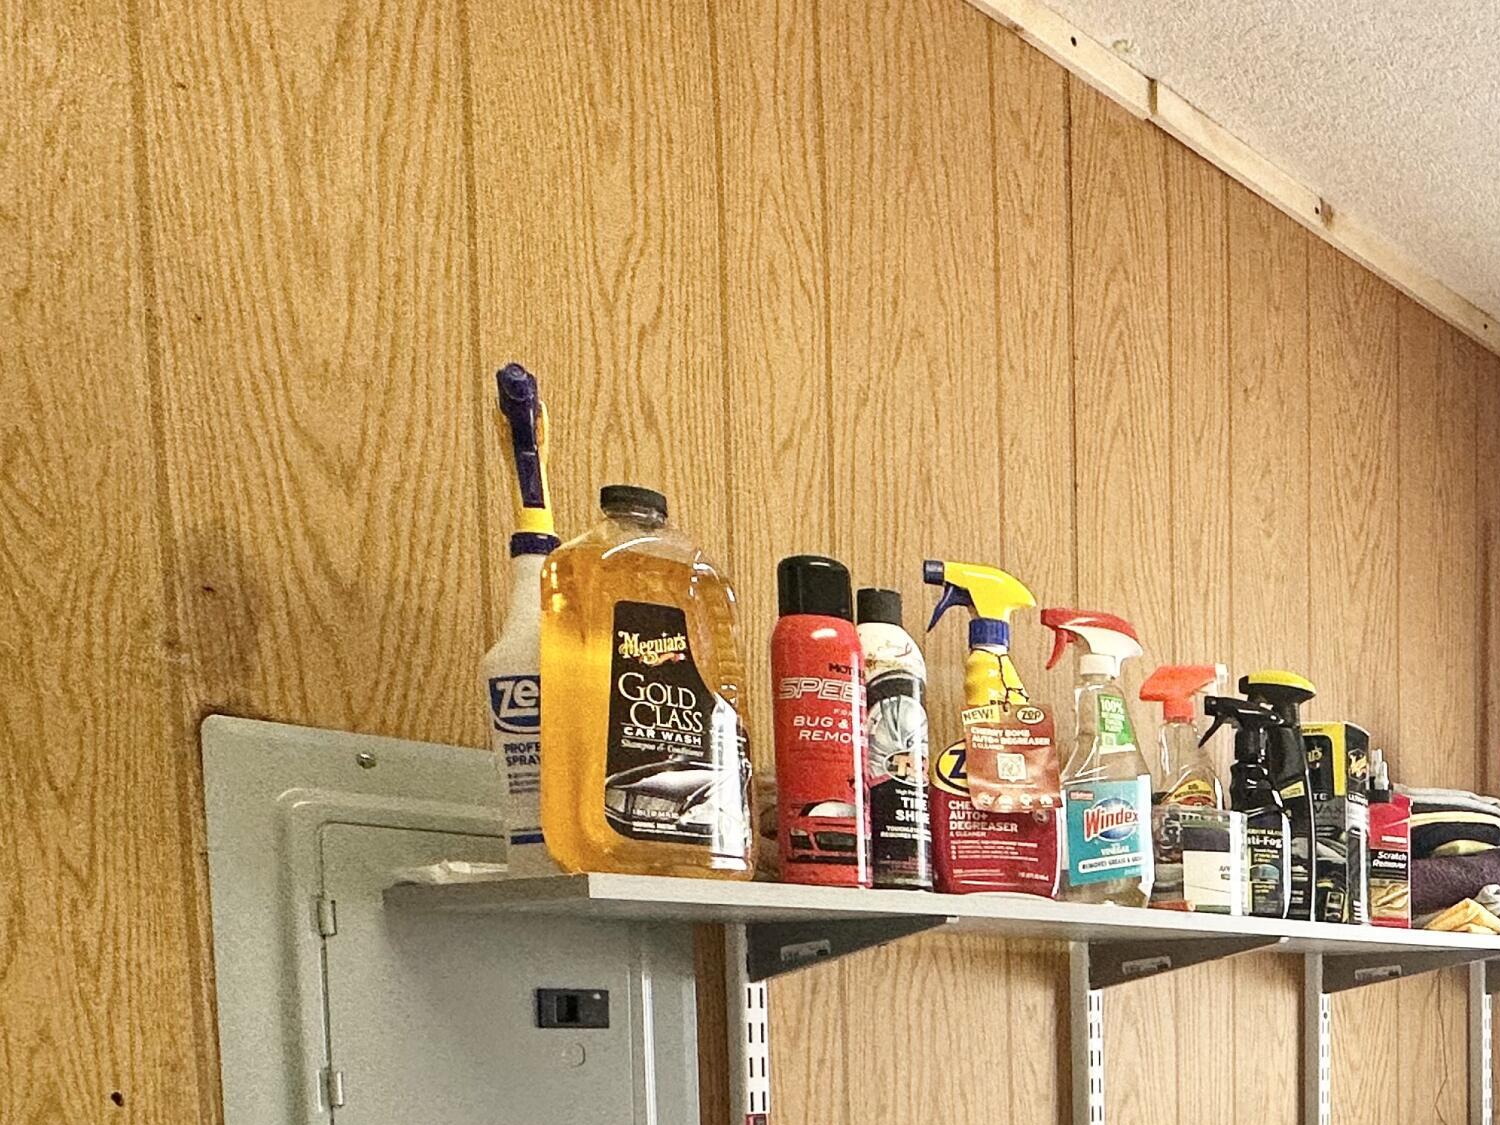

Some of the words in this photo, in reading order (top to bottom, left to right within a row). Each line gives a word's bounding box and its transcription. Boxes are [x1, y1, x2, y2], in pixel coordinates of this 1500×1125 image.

[618, 672, 697, 710] GOLD
[496, 679, 540, 718] Ze
[629, 702, 703, 733] CLASS
[963, 708, 994, 722] NEW!
[793, 716, 833, 728] BUG
[838, 719, 849, 730] &
[623, 726, 655, 738] CAR
[661, 731, 701, 745] WASH
[504, 743, 541, 754] PROFE
[949, 811, 989, 820] AUTO+
[949, 821, 1018, 832] DEGREASER
[1084, 807, 1139, 839] Windex
[1378, 851, 1407, 861] Scratch
[1372, 859, 1407, 870] Remover
